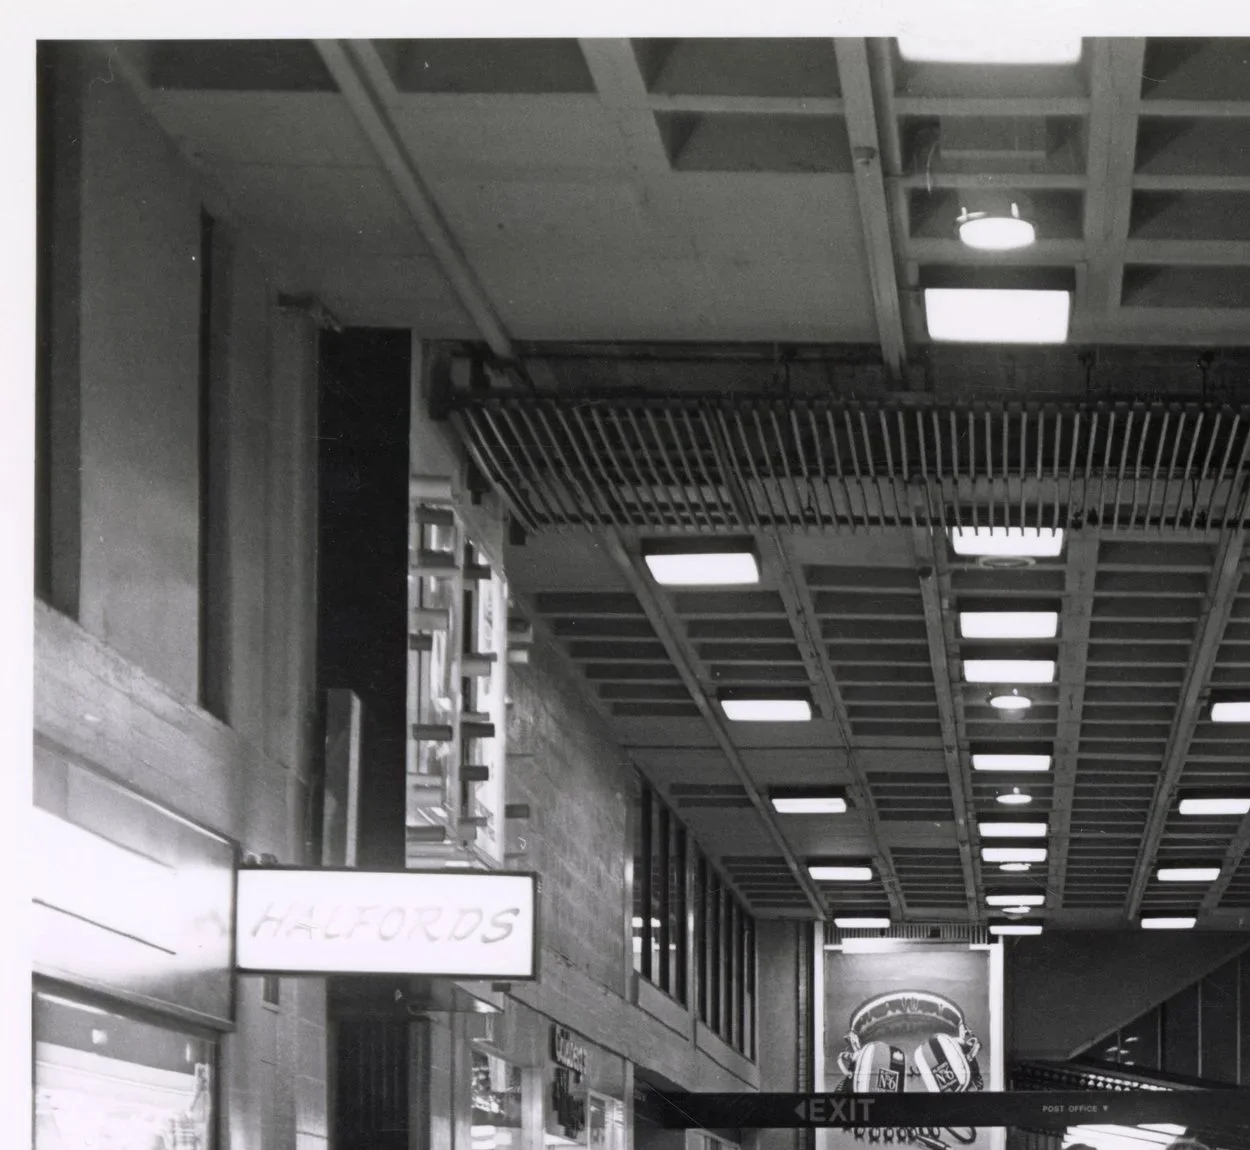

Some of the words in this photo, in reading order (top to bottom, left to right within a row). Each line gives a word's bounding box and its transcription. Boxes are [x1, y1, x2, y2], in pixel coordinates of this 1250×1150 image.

[250, 902, 521, 944] HALFORDS
[809, 1098, 876, 1122] EXIT
[1042, 1104, 1065, 1113] POST
[1068, 1104, 1098, 1113] OFFICE
